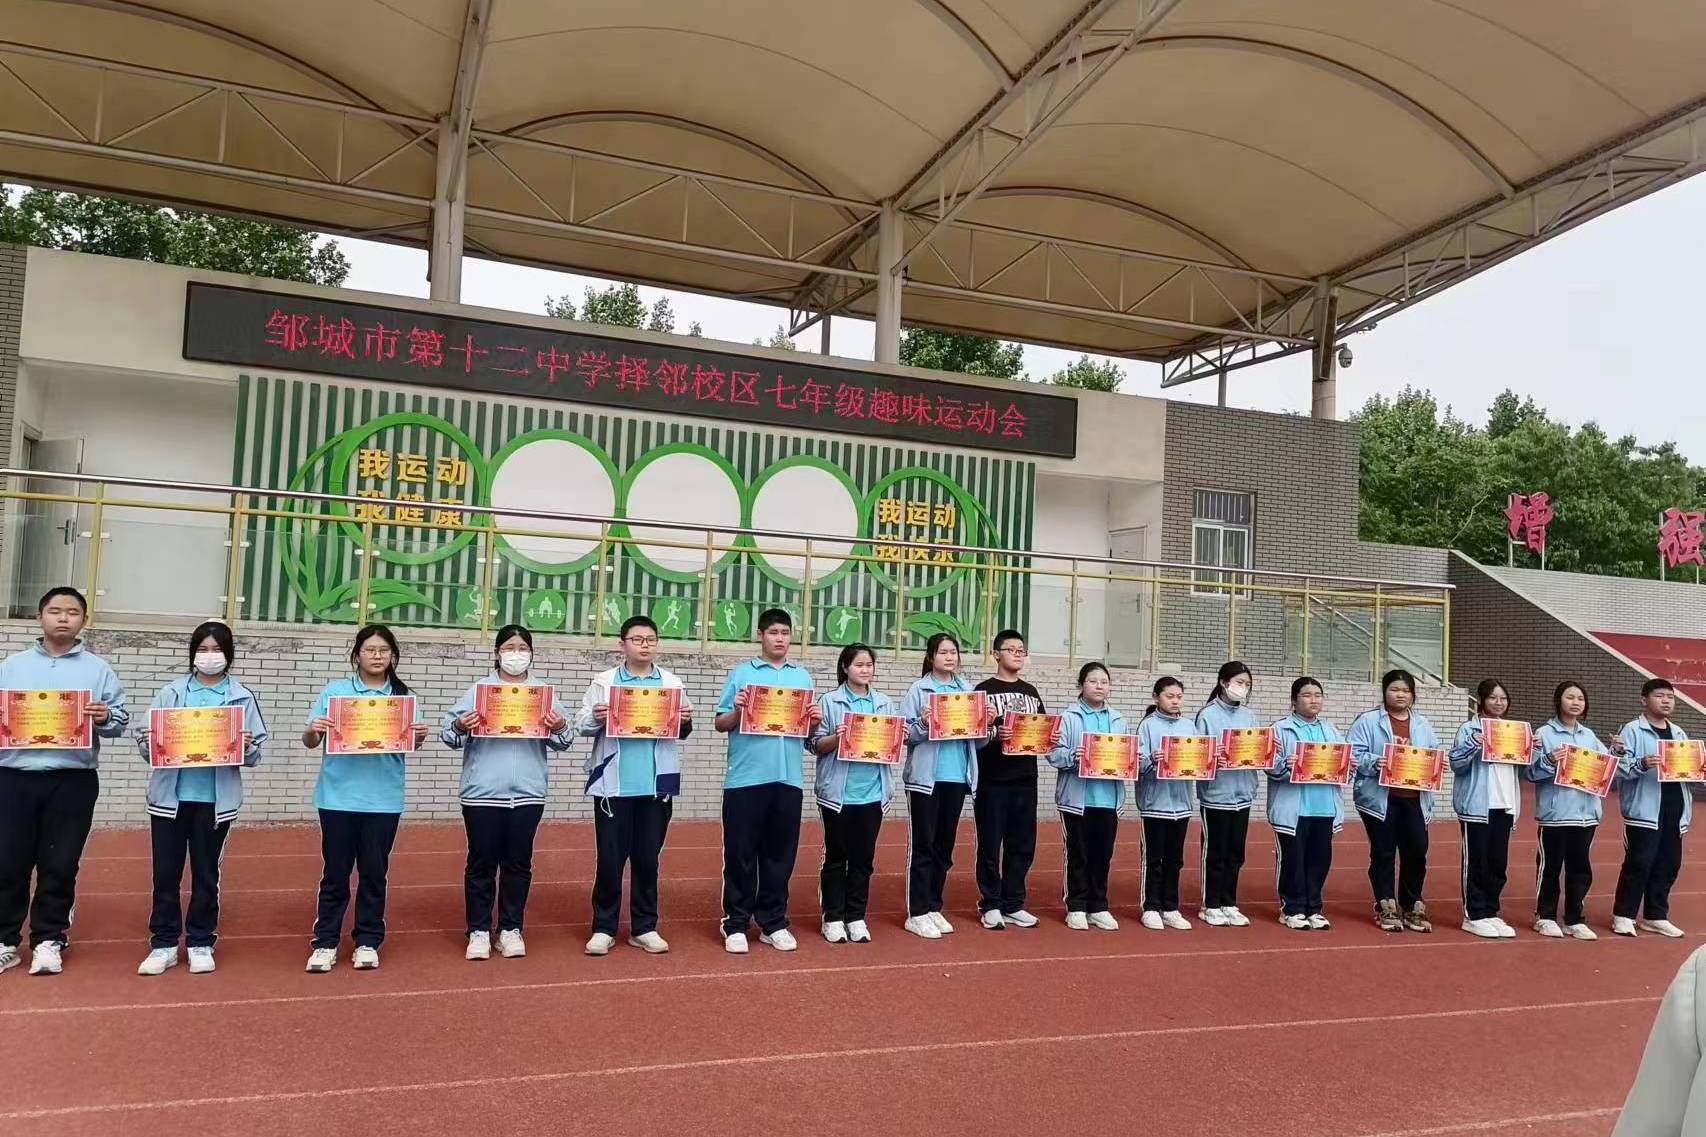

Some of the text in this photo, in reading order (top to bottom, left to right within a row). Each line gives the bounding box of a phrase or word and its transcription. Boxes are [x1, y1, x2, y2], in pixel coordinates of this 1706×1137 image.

[264, 307, 1029, 438] 邹城市第十二中学择邻校区七年级趣味运动会
[359, 448, 468, 486] 我运动
[879, 498, 957, 529] 我运动
